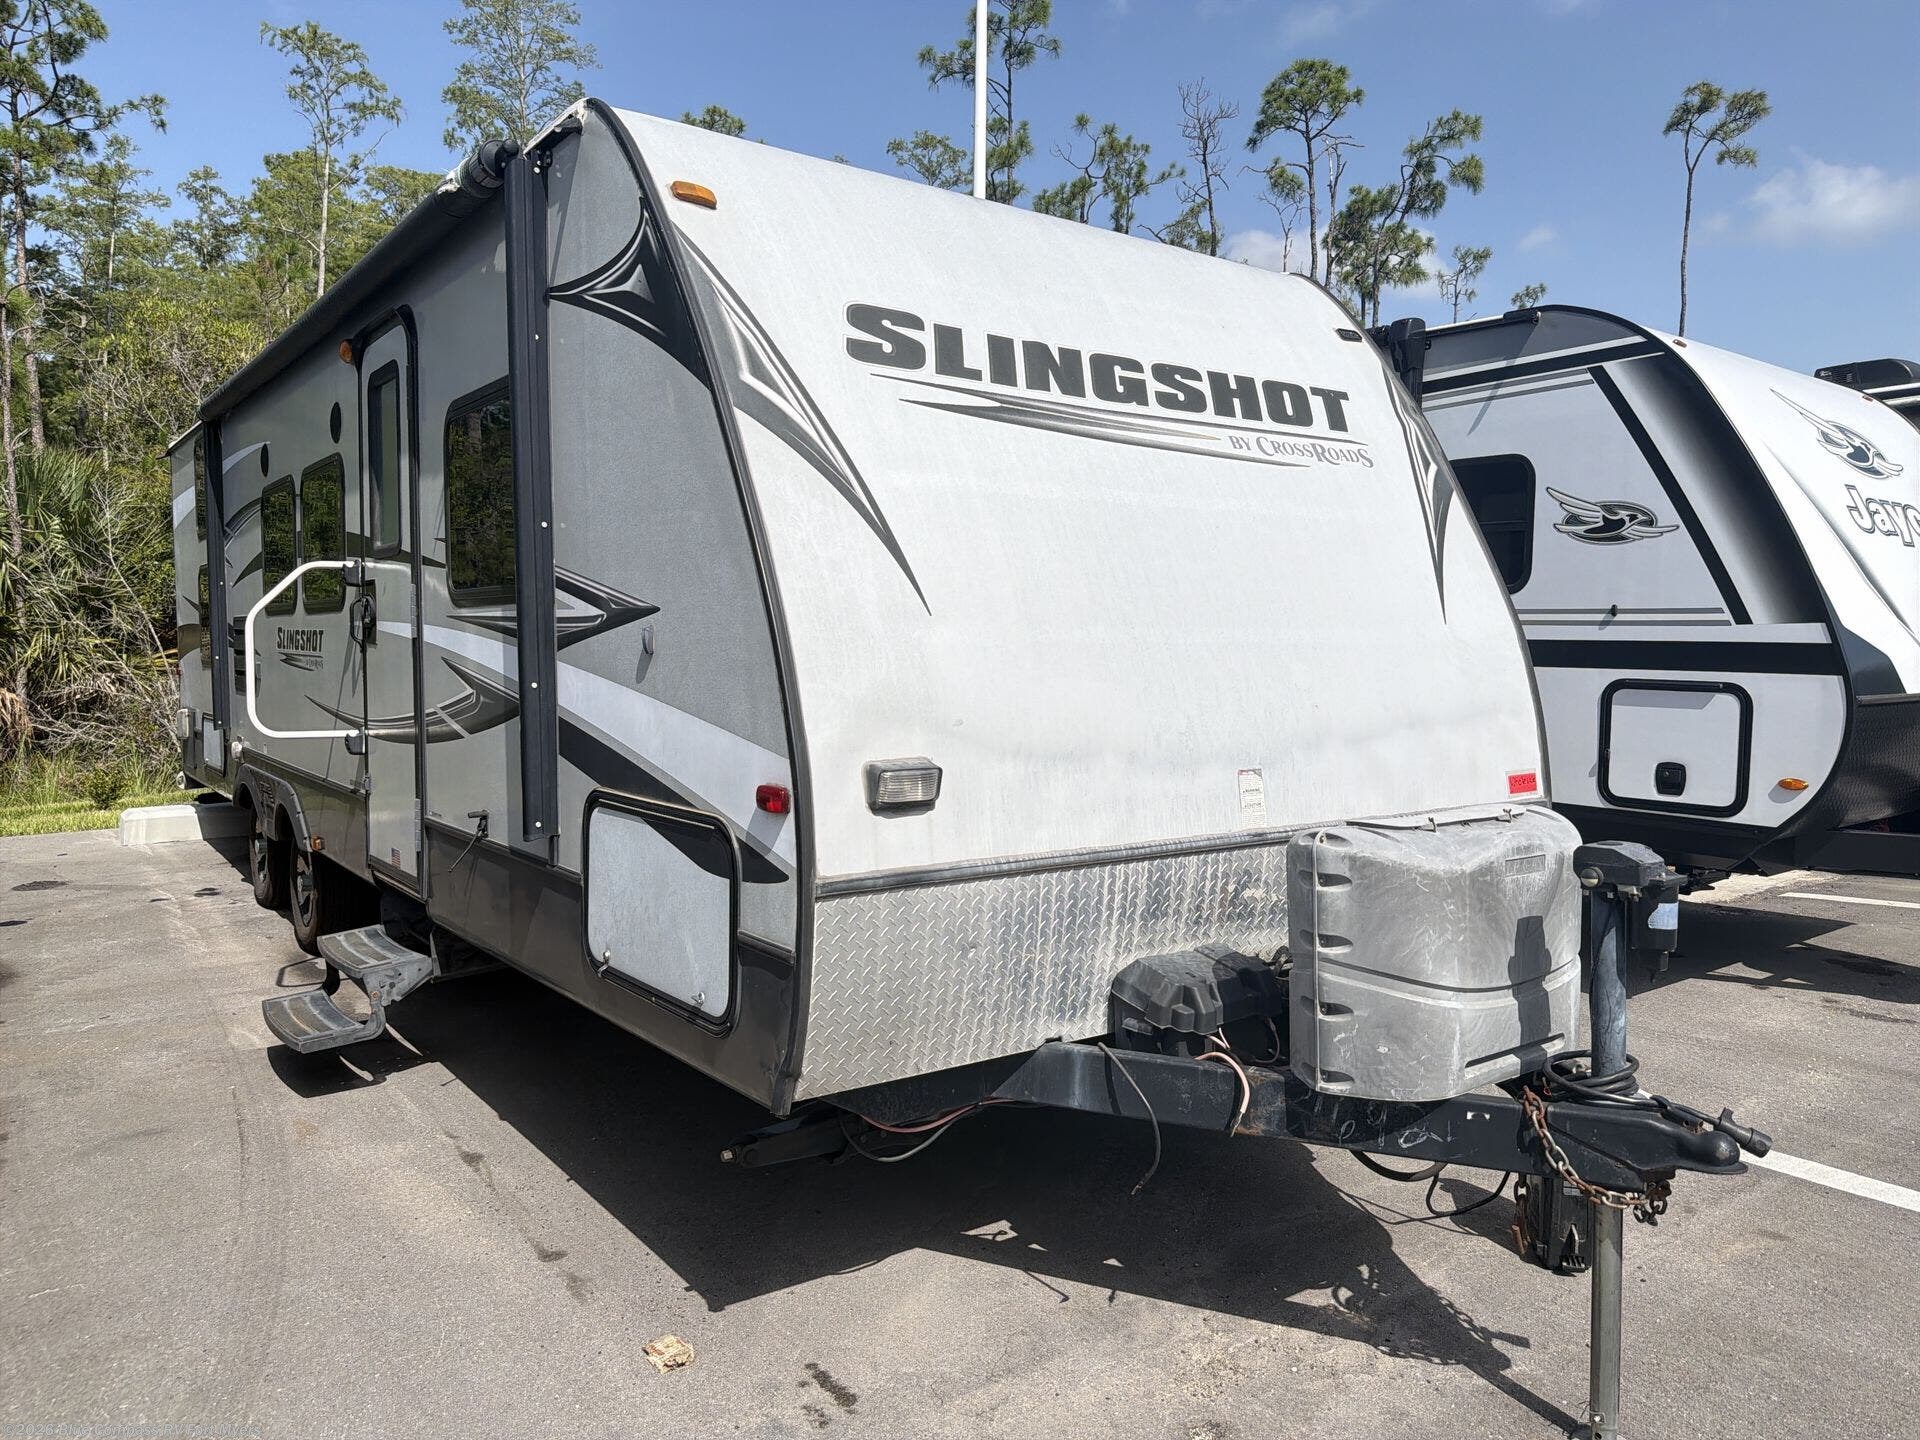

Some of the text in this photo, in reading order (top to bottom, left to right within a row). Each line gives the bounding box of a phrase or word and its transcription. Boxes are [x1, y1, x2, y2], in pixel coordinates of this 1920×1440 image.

[846, 303, 1350, 433] SLINGSHOT
[1228, 435, 1251, 451] BY
[277, 626, 324, 652] SLINGSHOT
